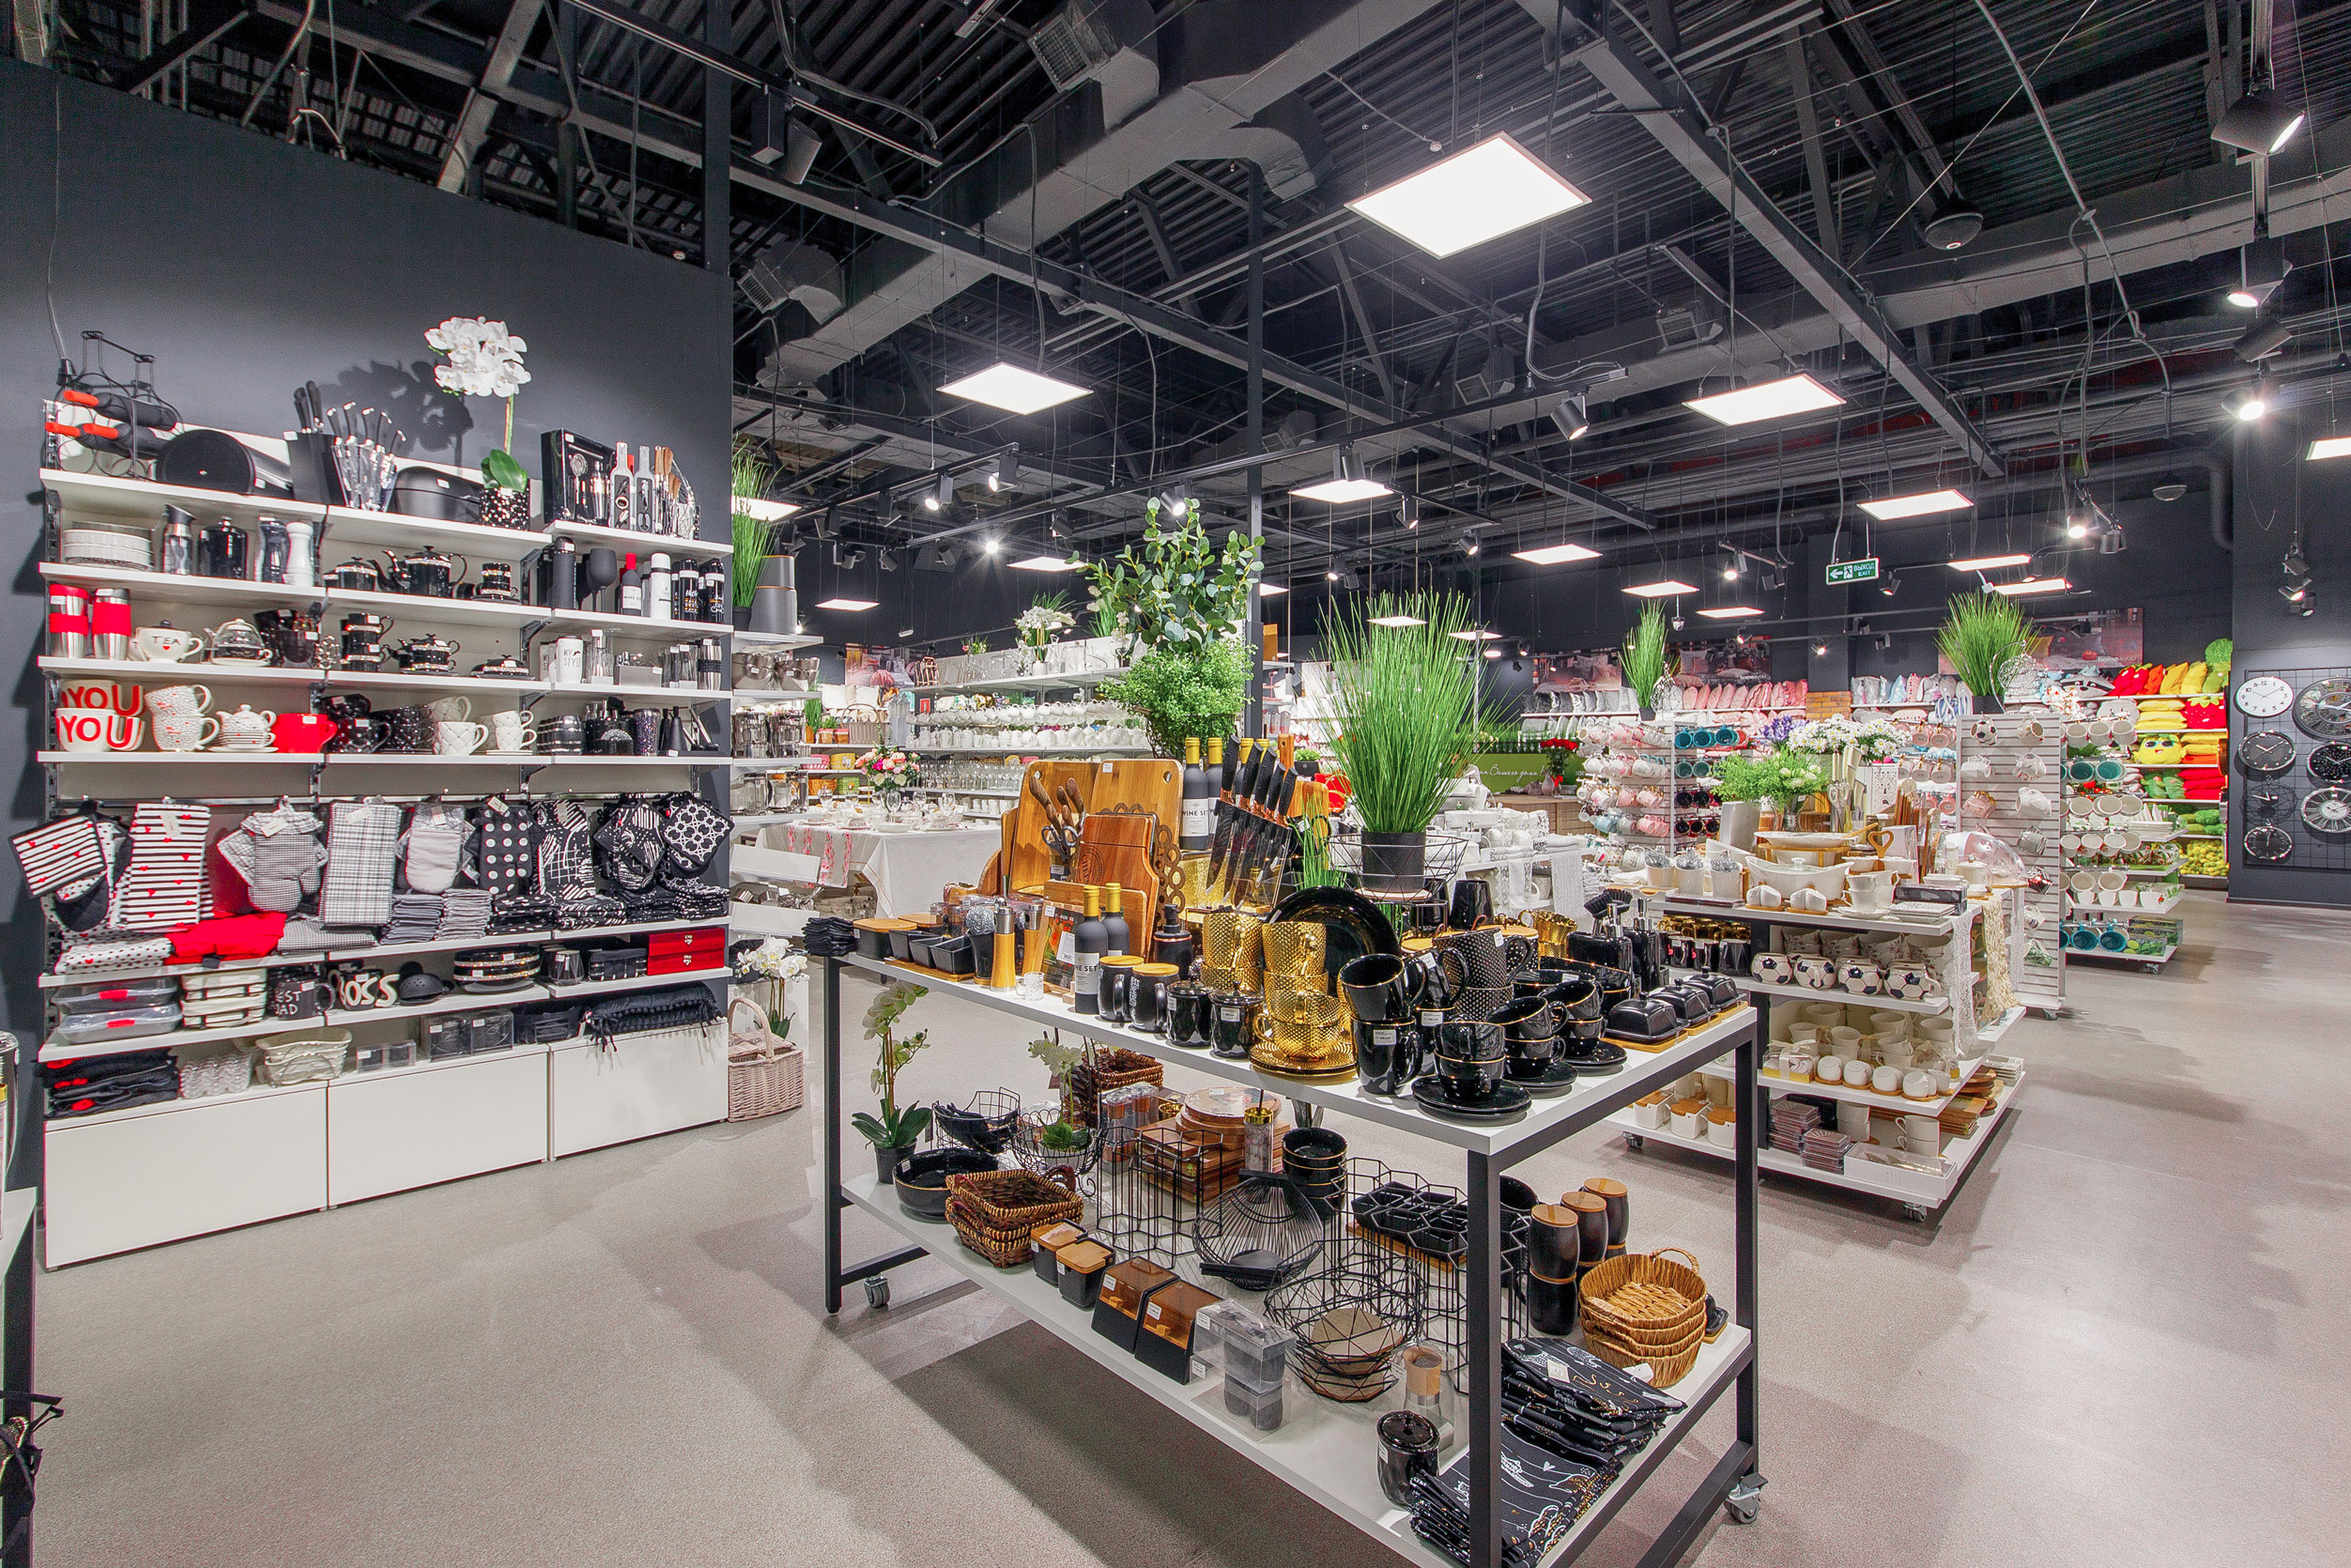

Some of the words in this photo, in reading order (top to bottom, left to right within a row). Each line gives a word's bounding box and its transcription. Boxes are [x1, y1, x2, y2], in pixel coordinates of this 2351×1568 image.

[1853, 562, 1875, 572] ВЫХОД
[151, 636, 181, 646] TEA
[563, 648, 573, 656] MY
[68, 684, 140, 716] YOU
[61, 715, 133, 748] YOU
[274, 990, 301, 1003] EST
